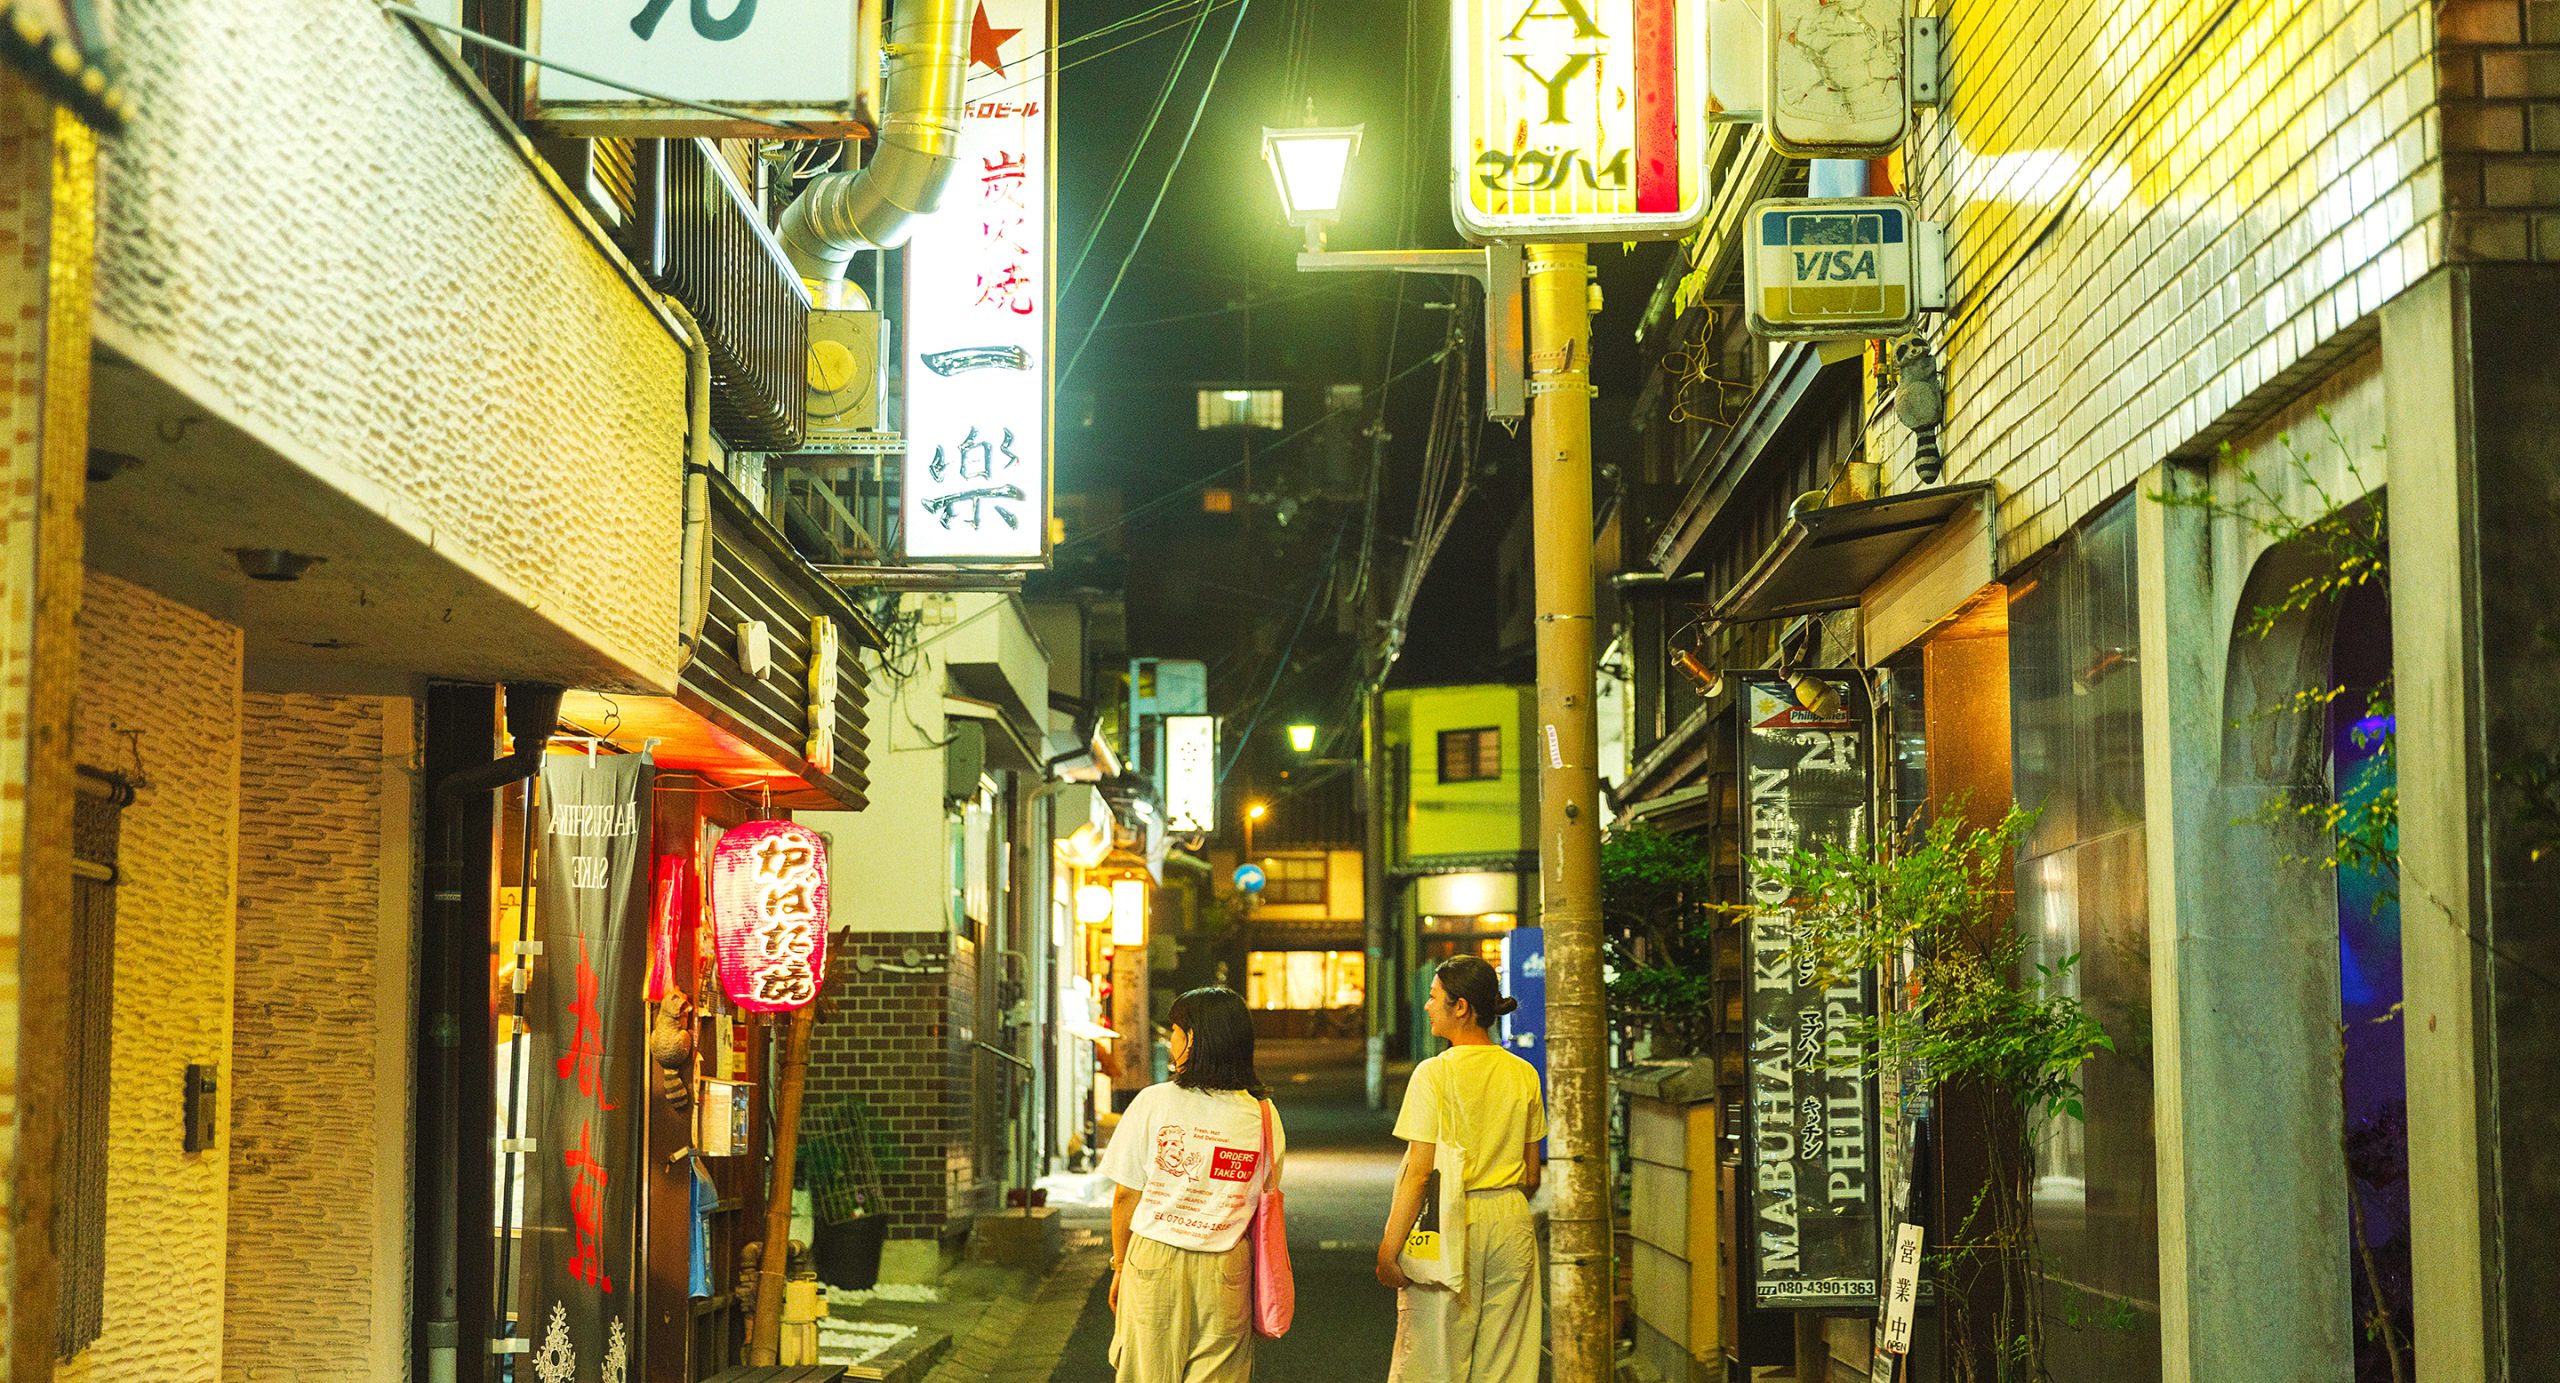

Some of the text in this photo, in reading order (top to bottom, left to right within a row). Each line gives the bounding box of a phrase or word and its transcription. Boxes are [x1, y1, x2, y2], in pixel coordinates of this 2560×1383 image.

[975, 150, 1034, 315] 炭火焼
[1792, 250, 1876, 281] VISA
[1797, 730, 1860, 771] 2F
[1796, 1011, 1824, 1073] マブハイ
[1755, 1019, 1801, 1273] MABUHAY
[1801, 1098, 1824, 1160] キッチン
[1213, 1168, 1237, 1179] TAKE
[1219, 1150, 1255, 1163] ORDERS
[1230, 1160, 1242, 1170] TO
[1777, 1281, 1874, 1295] 080-4390-1363
[1890, 1239, 1917, 1341] 営業中
[1886, 1339, 1907, 1352] OPEN
